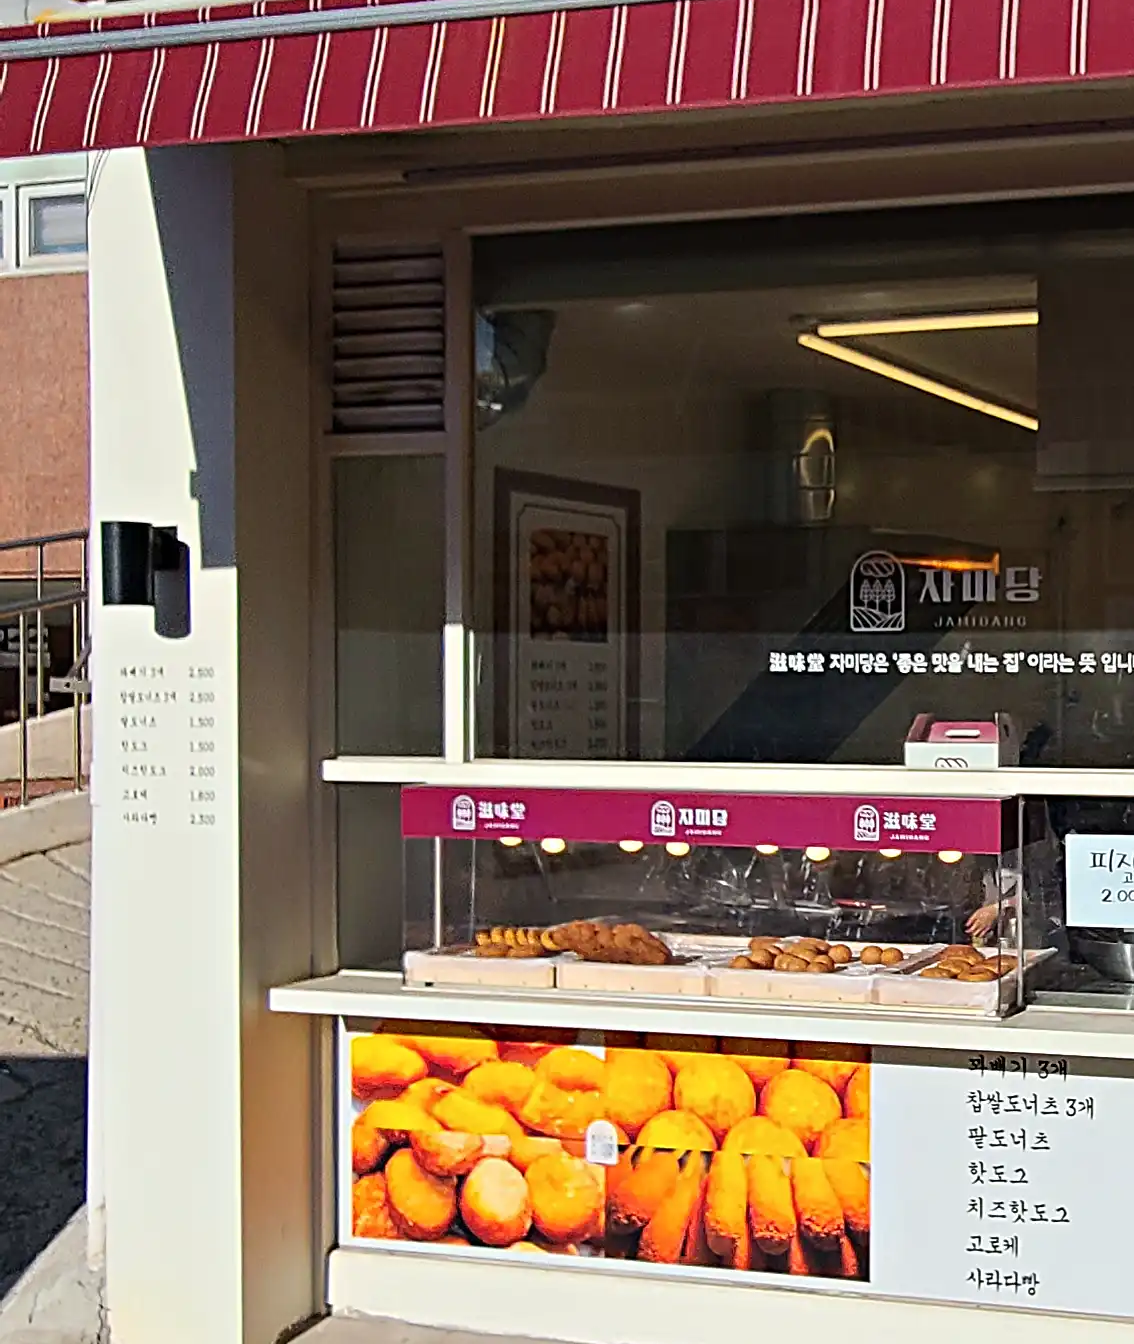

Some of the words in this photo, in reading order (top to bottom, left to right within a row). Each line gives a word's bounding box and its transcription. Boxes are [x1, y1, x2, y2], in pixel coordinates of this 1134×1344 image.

[918, 567, 1043, 604] 자미당
[829, 652, 890, 674] 자미당은
[931, 652, 963, 674] 맛을
[967, 652, 1000, 674] 내는
[1027, 652, 1075, 674] 이라는
[1078, 652, 1097, 674] 뜻
[1037, 1058, 1068, 1082] 3개
[966, 1089, 1059, 1117] 찹쌀도너츠
[1065, 1096, 1095, 1120] 3개
[967, 1127, 1051, 1152] 팥도너츠
[967, 1160, 1029, 1185] 핫도그
[966, 1197, 1071, 1224] 치즈핫도그
[966, 1235, 1019, 1258] 고로케
[966, 1269, 1040, 1296] 사라다빵
